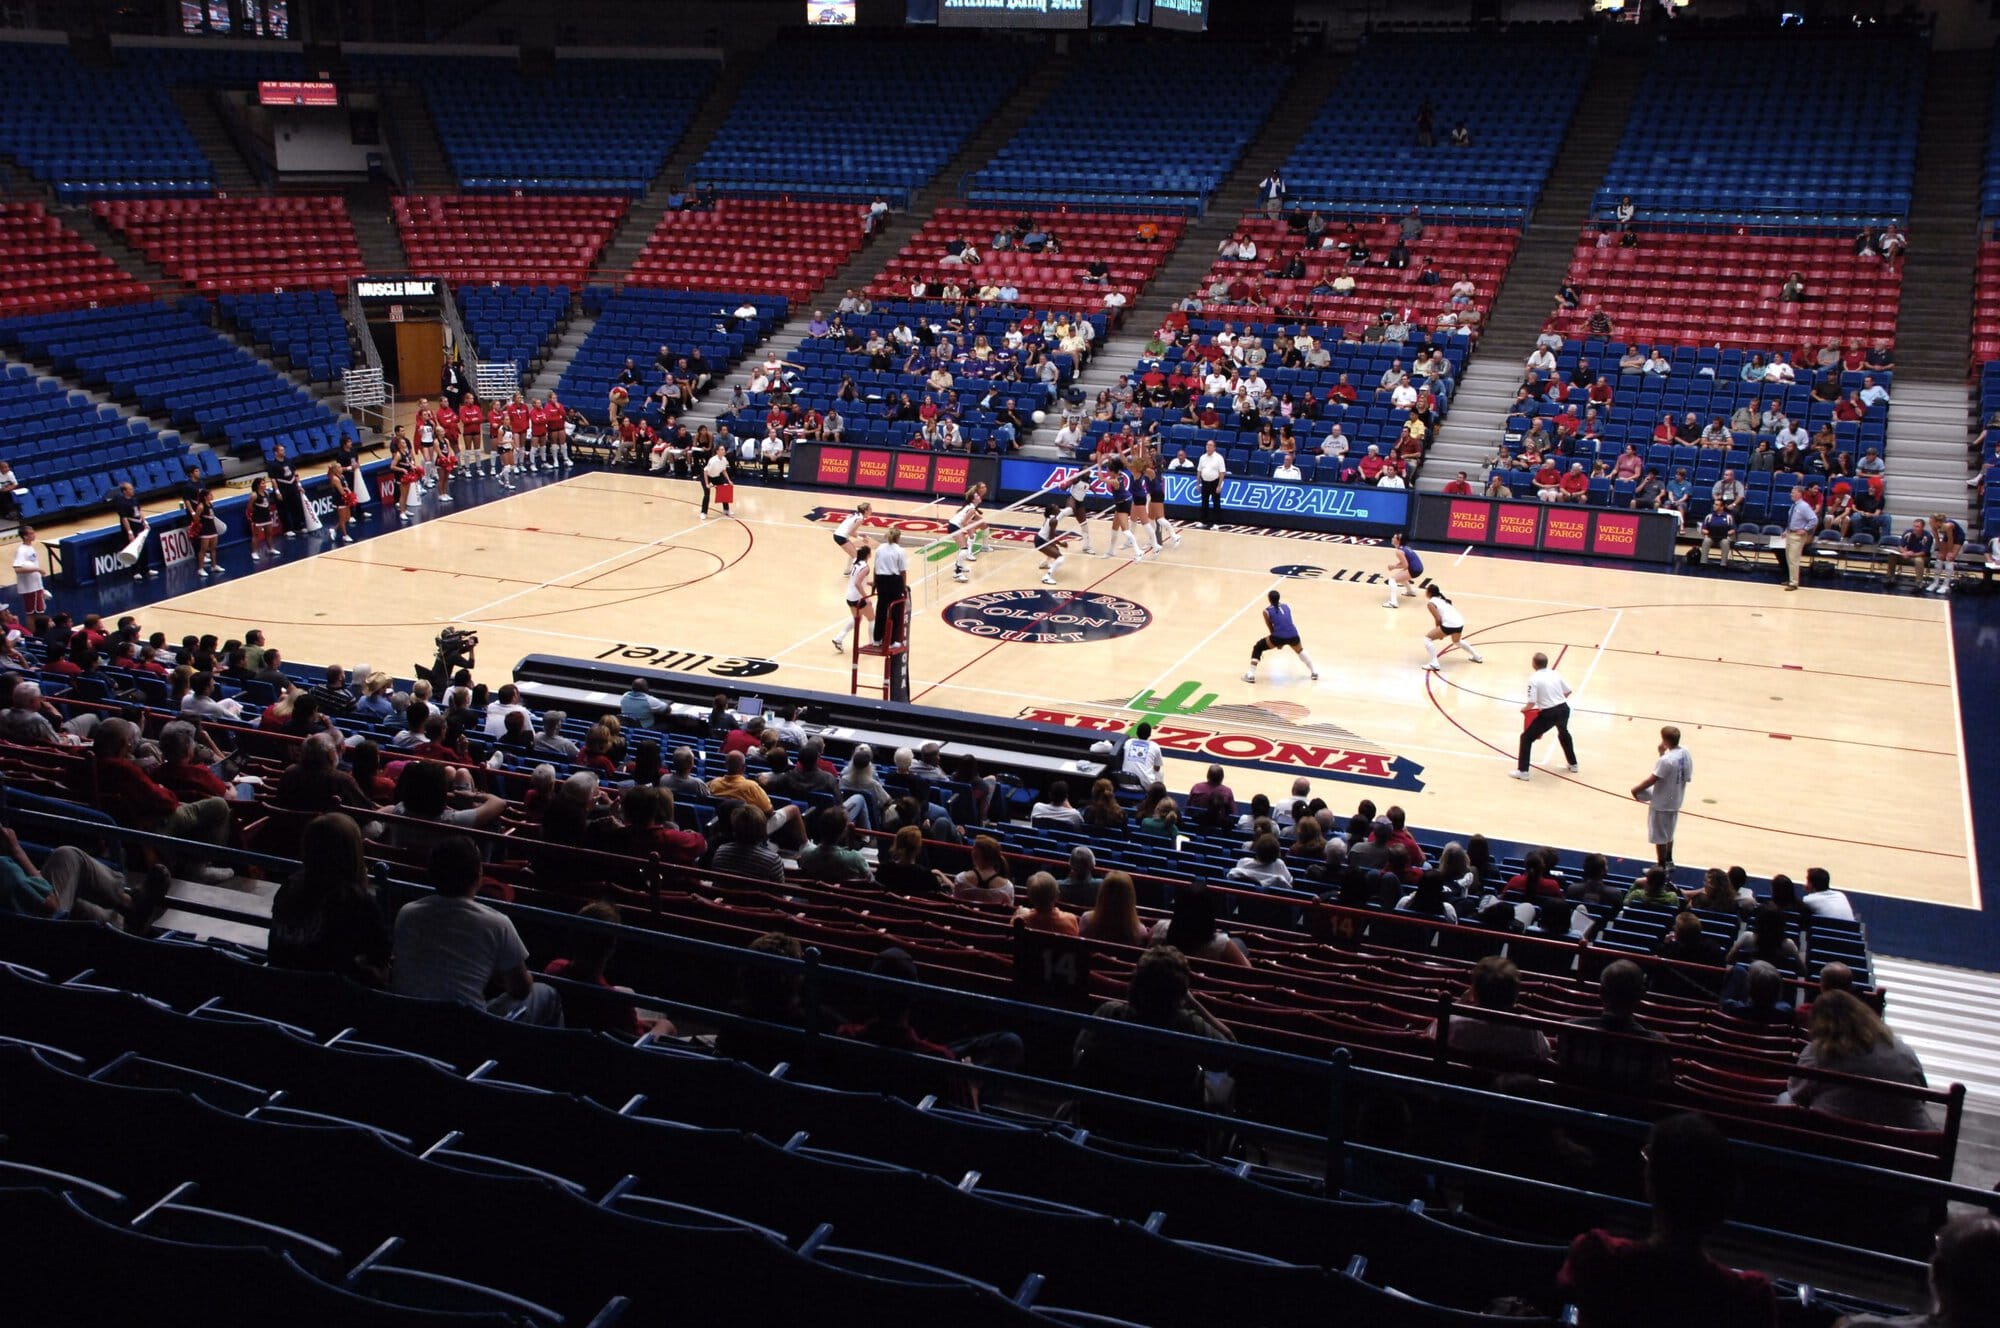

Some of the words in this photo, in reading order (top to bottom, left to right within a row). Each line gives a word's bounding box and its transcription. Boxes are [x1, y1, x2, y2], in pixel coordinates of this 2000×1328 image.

[357, 282, 403, 297] MUSCLE
[404, 281, 434, 296] MILK
[822, 458, 849, 467] WELLS
[860, 461, 887, 470] WELLS
[821, 465, 848, 474] FARGO
[859, 468, 886, 477] FARGO
[899, 464, 927, 473] WELLS
[938, 467, 966, 477] WELLS
[898, 471, 926, 480] FARGO
[937, 474, 965, 484] FARGO
[1166, 475, 1357, 517] VOLEYBALL
[312, 495, 334, 516] OISE
[1452, 512, 1486, 522] WELLS
[1500, 516, 1534, 526] WELLS
[1452, 520, 1485, 530] FARGO
[1499, 524, 1533, 534] FARGO
[1550, 520, 1584, 531] WELLS
[1549, 529, 1583, 539] FARGO
[1599, 525, 1634, 536] WELLS
[1599, 533, 1633, 544] FARGO
[954, 590, 1041, 610] LUTE
[1087, 595, 1147, 629] BOBBI
[983, 606, 1111, 629] OLSON
[953, 618, 1085, 643] COURT
[1041, 949, 1078, 985] 14
